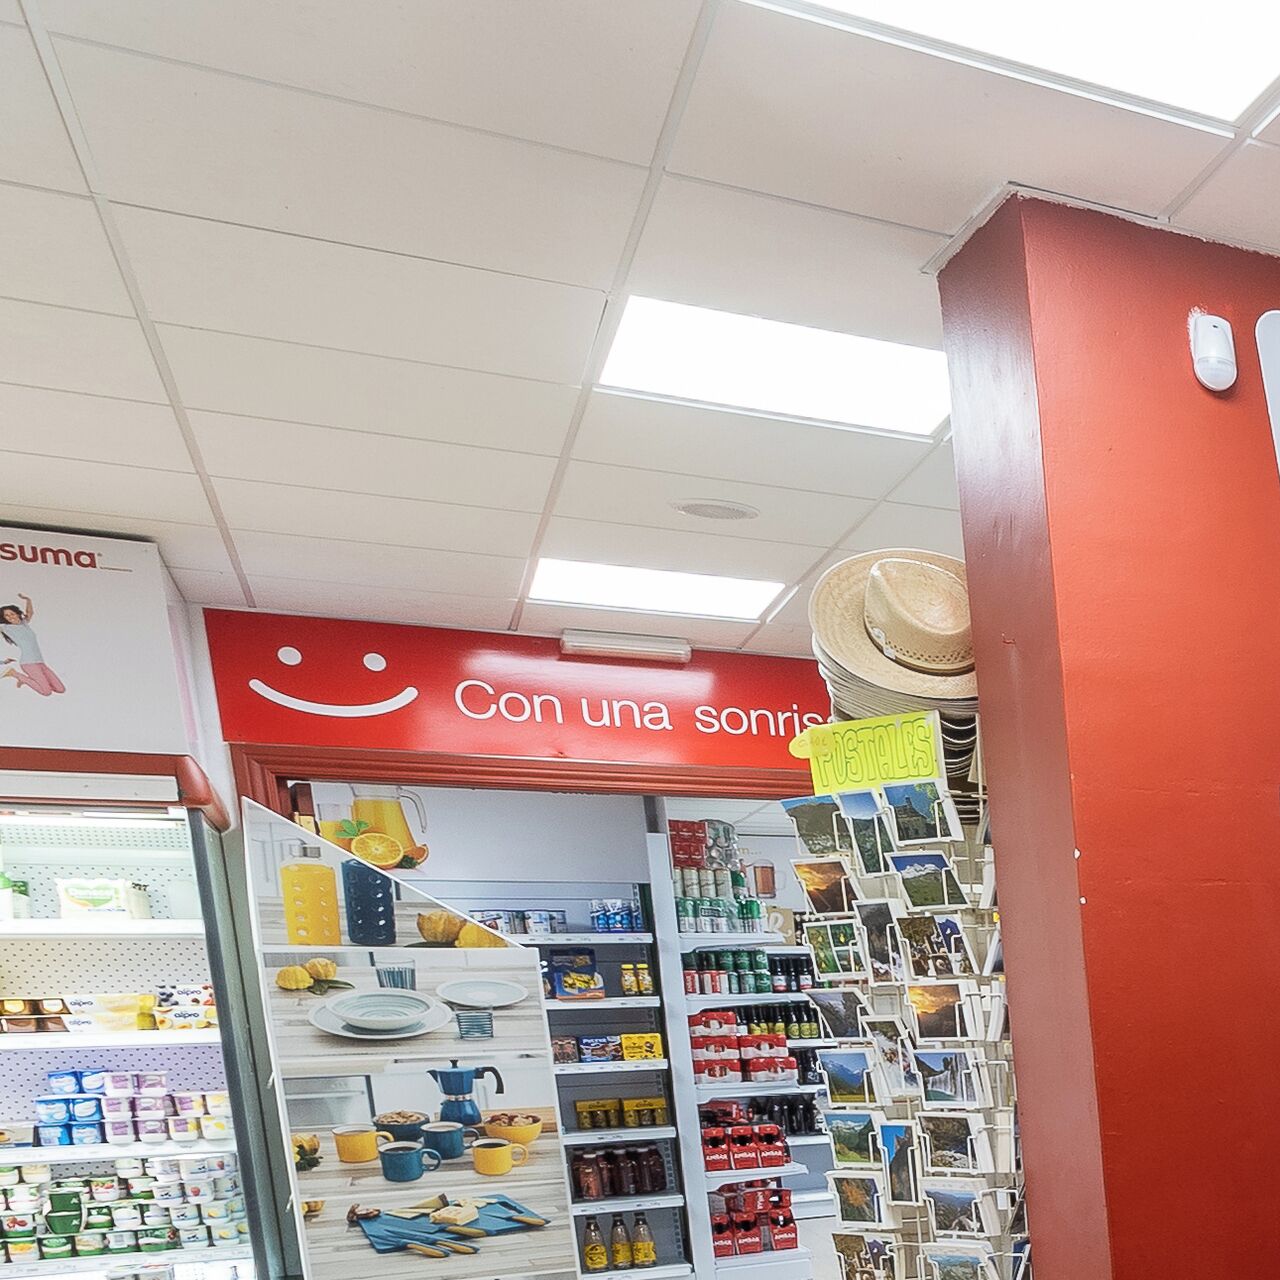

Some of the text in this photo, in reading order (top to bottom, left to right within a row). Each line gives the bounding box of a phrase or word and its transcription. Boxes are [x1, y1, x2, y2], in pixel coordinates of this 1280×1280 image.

[454, 679, 833, 738] Con una sonris
[815, 717, 935, 787] POSTALES
[177, 987, 202, 998] alpro
[174, 1009, 200, 1021] alpro
